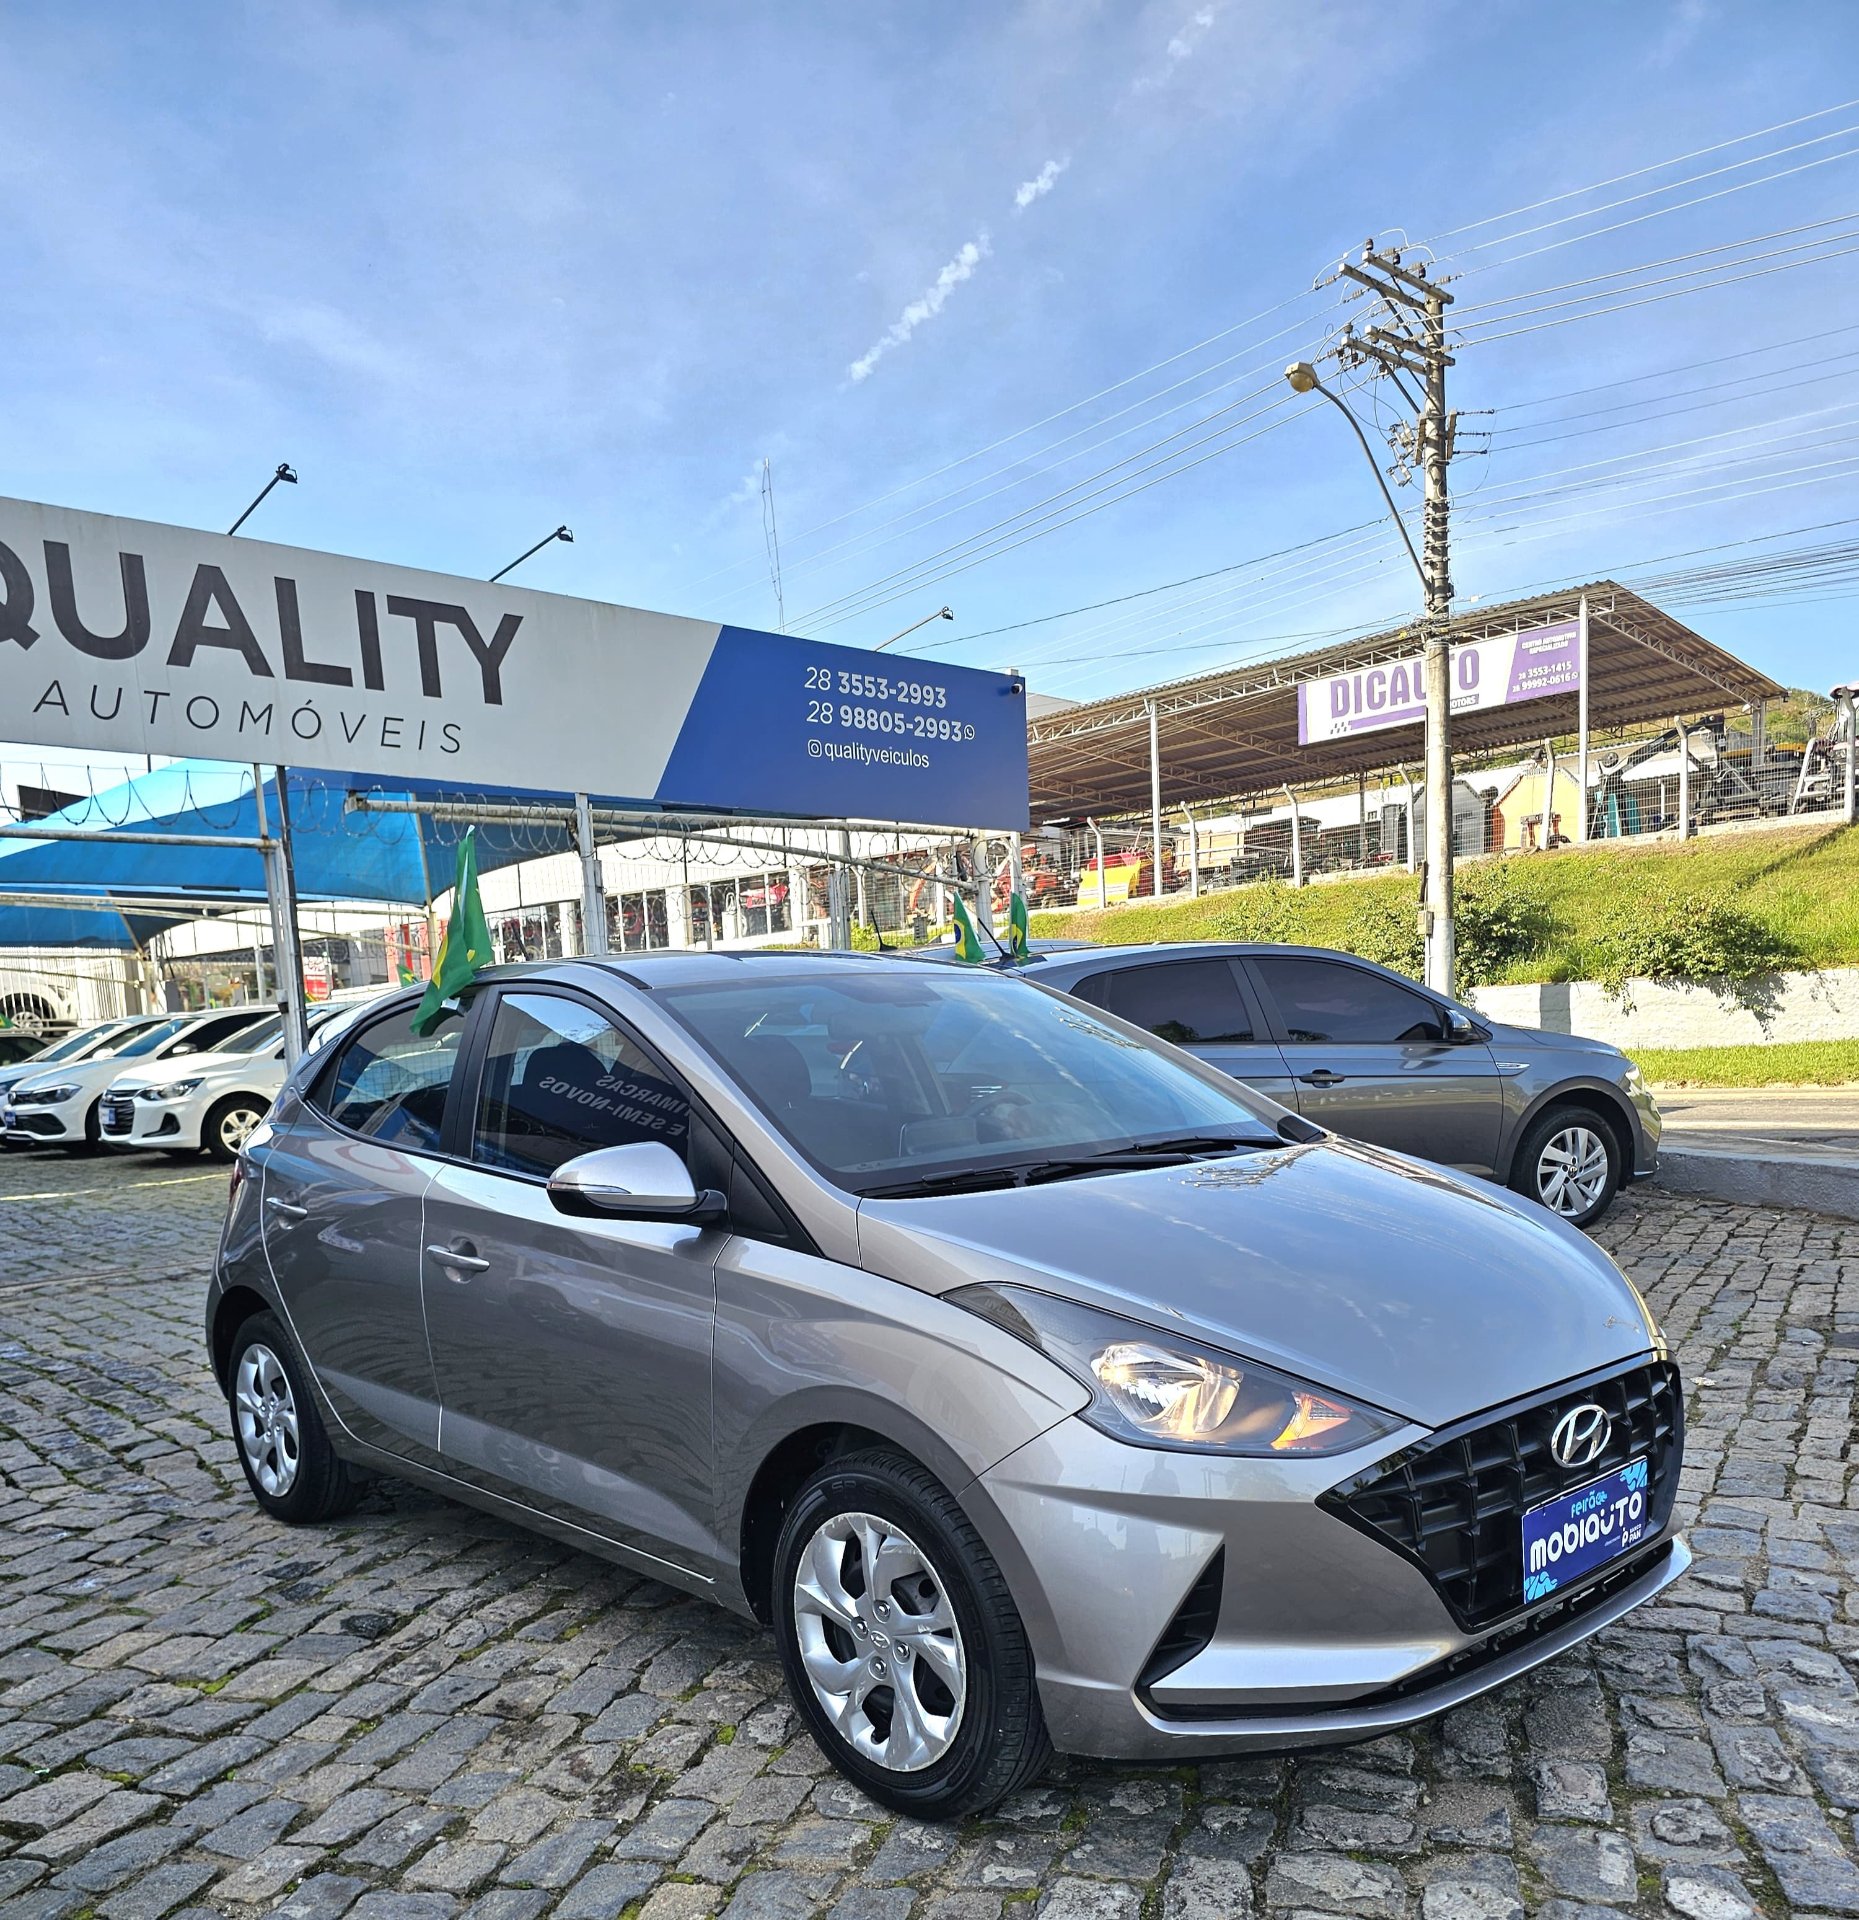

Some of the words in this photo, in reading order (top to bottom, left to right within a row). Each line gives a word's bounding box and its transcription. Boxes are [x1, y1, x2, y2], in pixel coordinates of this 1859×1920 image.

[1330, 649, 1480, 718] DICAUO
[1521, 672, 1571, 691] 99992-0616
[1527, 660, 1572, 679] 3553-1415
[804, 666, 831, 691] 28
[837, 671, 947, 709] 3553-2993
[1449, 695, 1476, 709] OTORS
[33, 679, 462, 754] AUTOMÓVEIS
[806, 700, 834, 725] 28
[839, 704, 962, 742] 98805-2993
[824, 742, 930, 768] qualityveiculos
